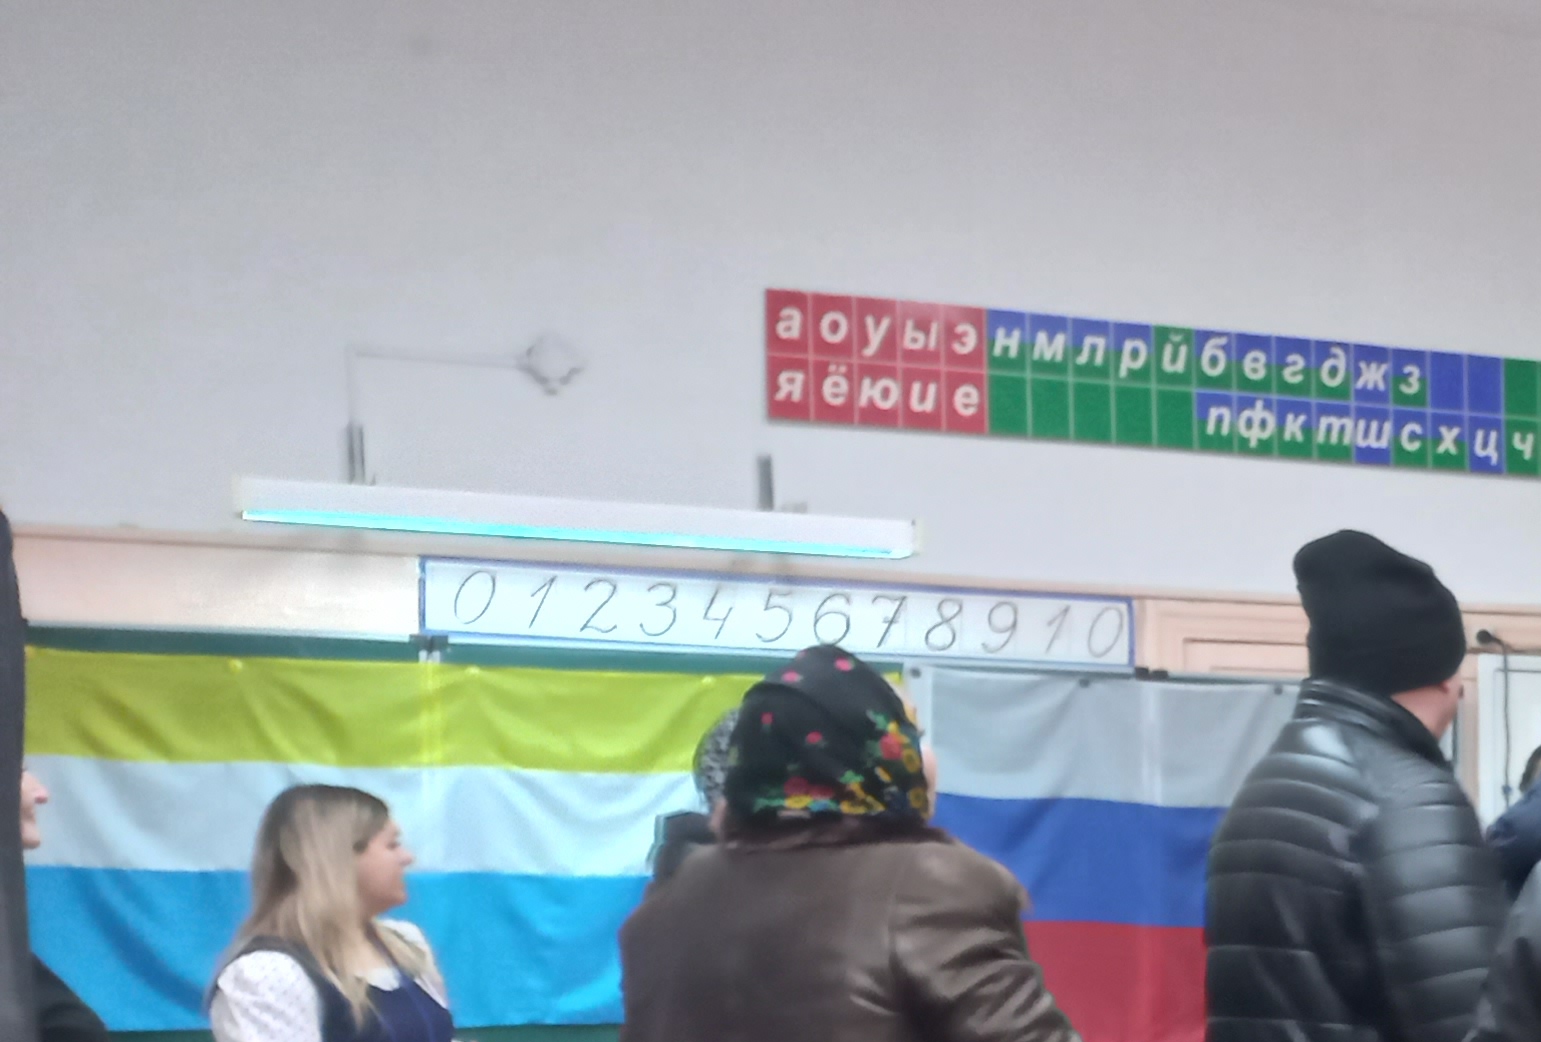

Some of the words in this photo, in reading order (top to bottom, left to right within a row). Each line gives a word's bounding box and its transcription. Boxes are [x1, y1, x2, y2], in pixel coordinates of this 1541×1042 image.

[453, 569, 497, 625] 0
[528, 575, 558, 629] 1
[580, 578, 618, 634] 2
[639, 582, 678, 637] 3
[702, 585, 733, 640] 4
[755, 588, 794, 643] 5
[813, 592, 852, 646] 6
[871, 594, 908, 649] 7
[924, 598, 963, 652] 8
[981, 600, 1019, 655] 9
